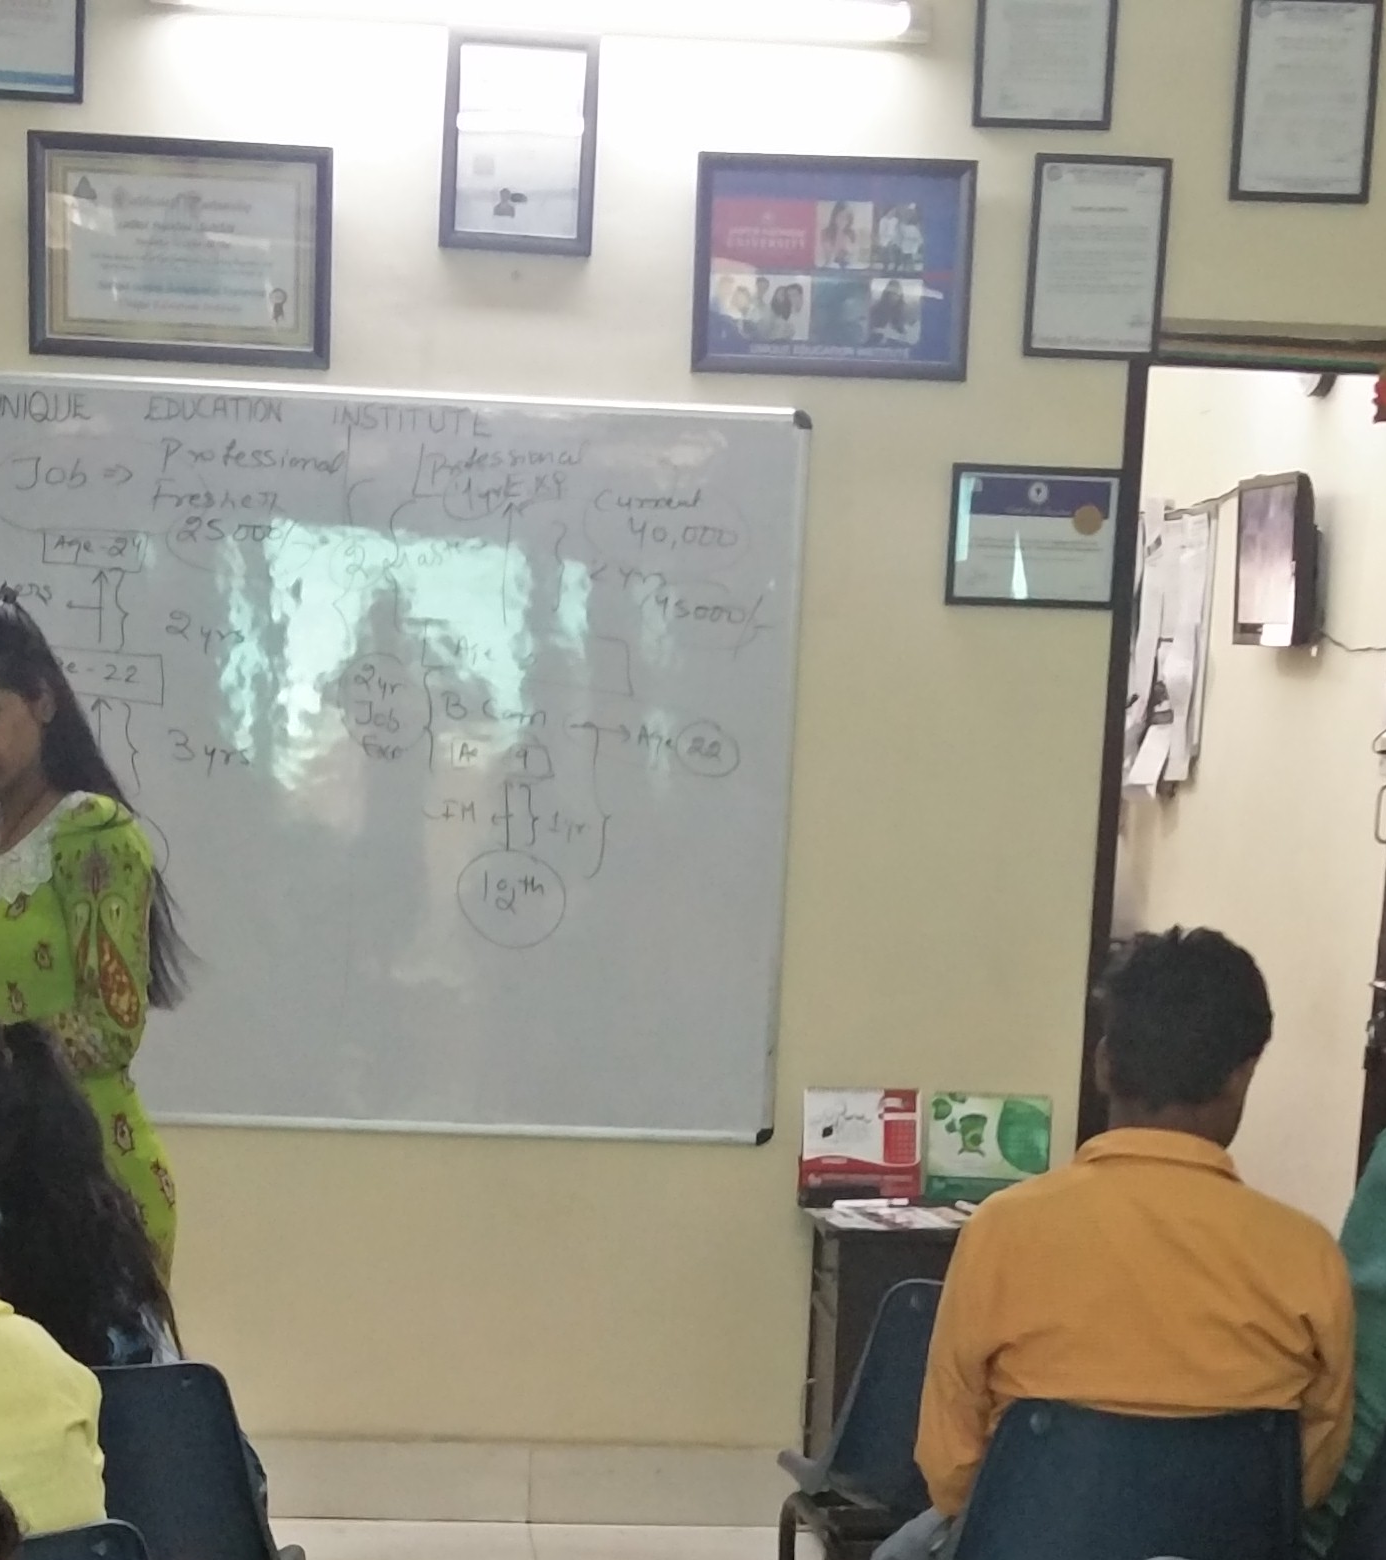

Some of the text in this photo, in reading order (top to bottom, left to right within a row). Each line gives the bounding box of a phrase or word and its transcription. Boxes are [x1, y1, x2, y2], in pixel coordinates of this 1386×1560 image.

[143, 395, 283, 423] EDUCATION
[332, 405, 493, 438] INSTITUTE
[11, 437, 348, 491] Job Professional
[628, 517, 739, 550] 40,000
